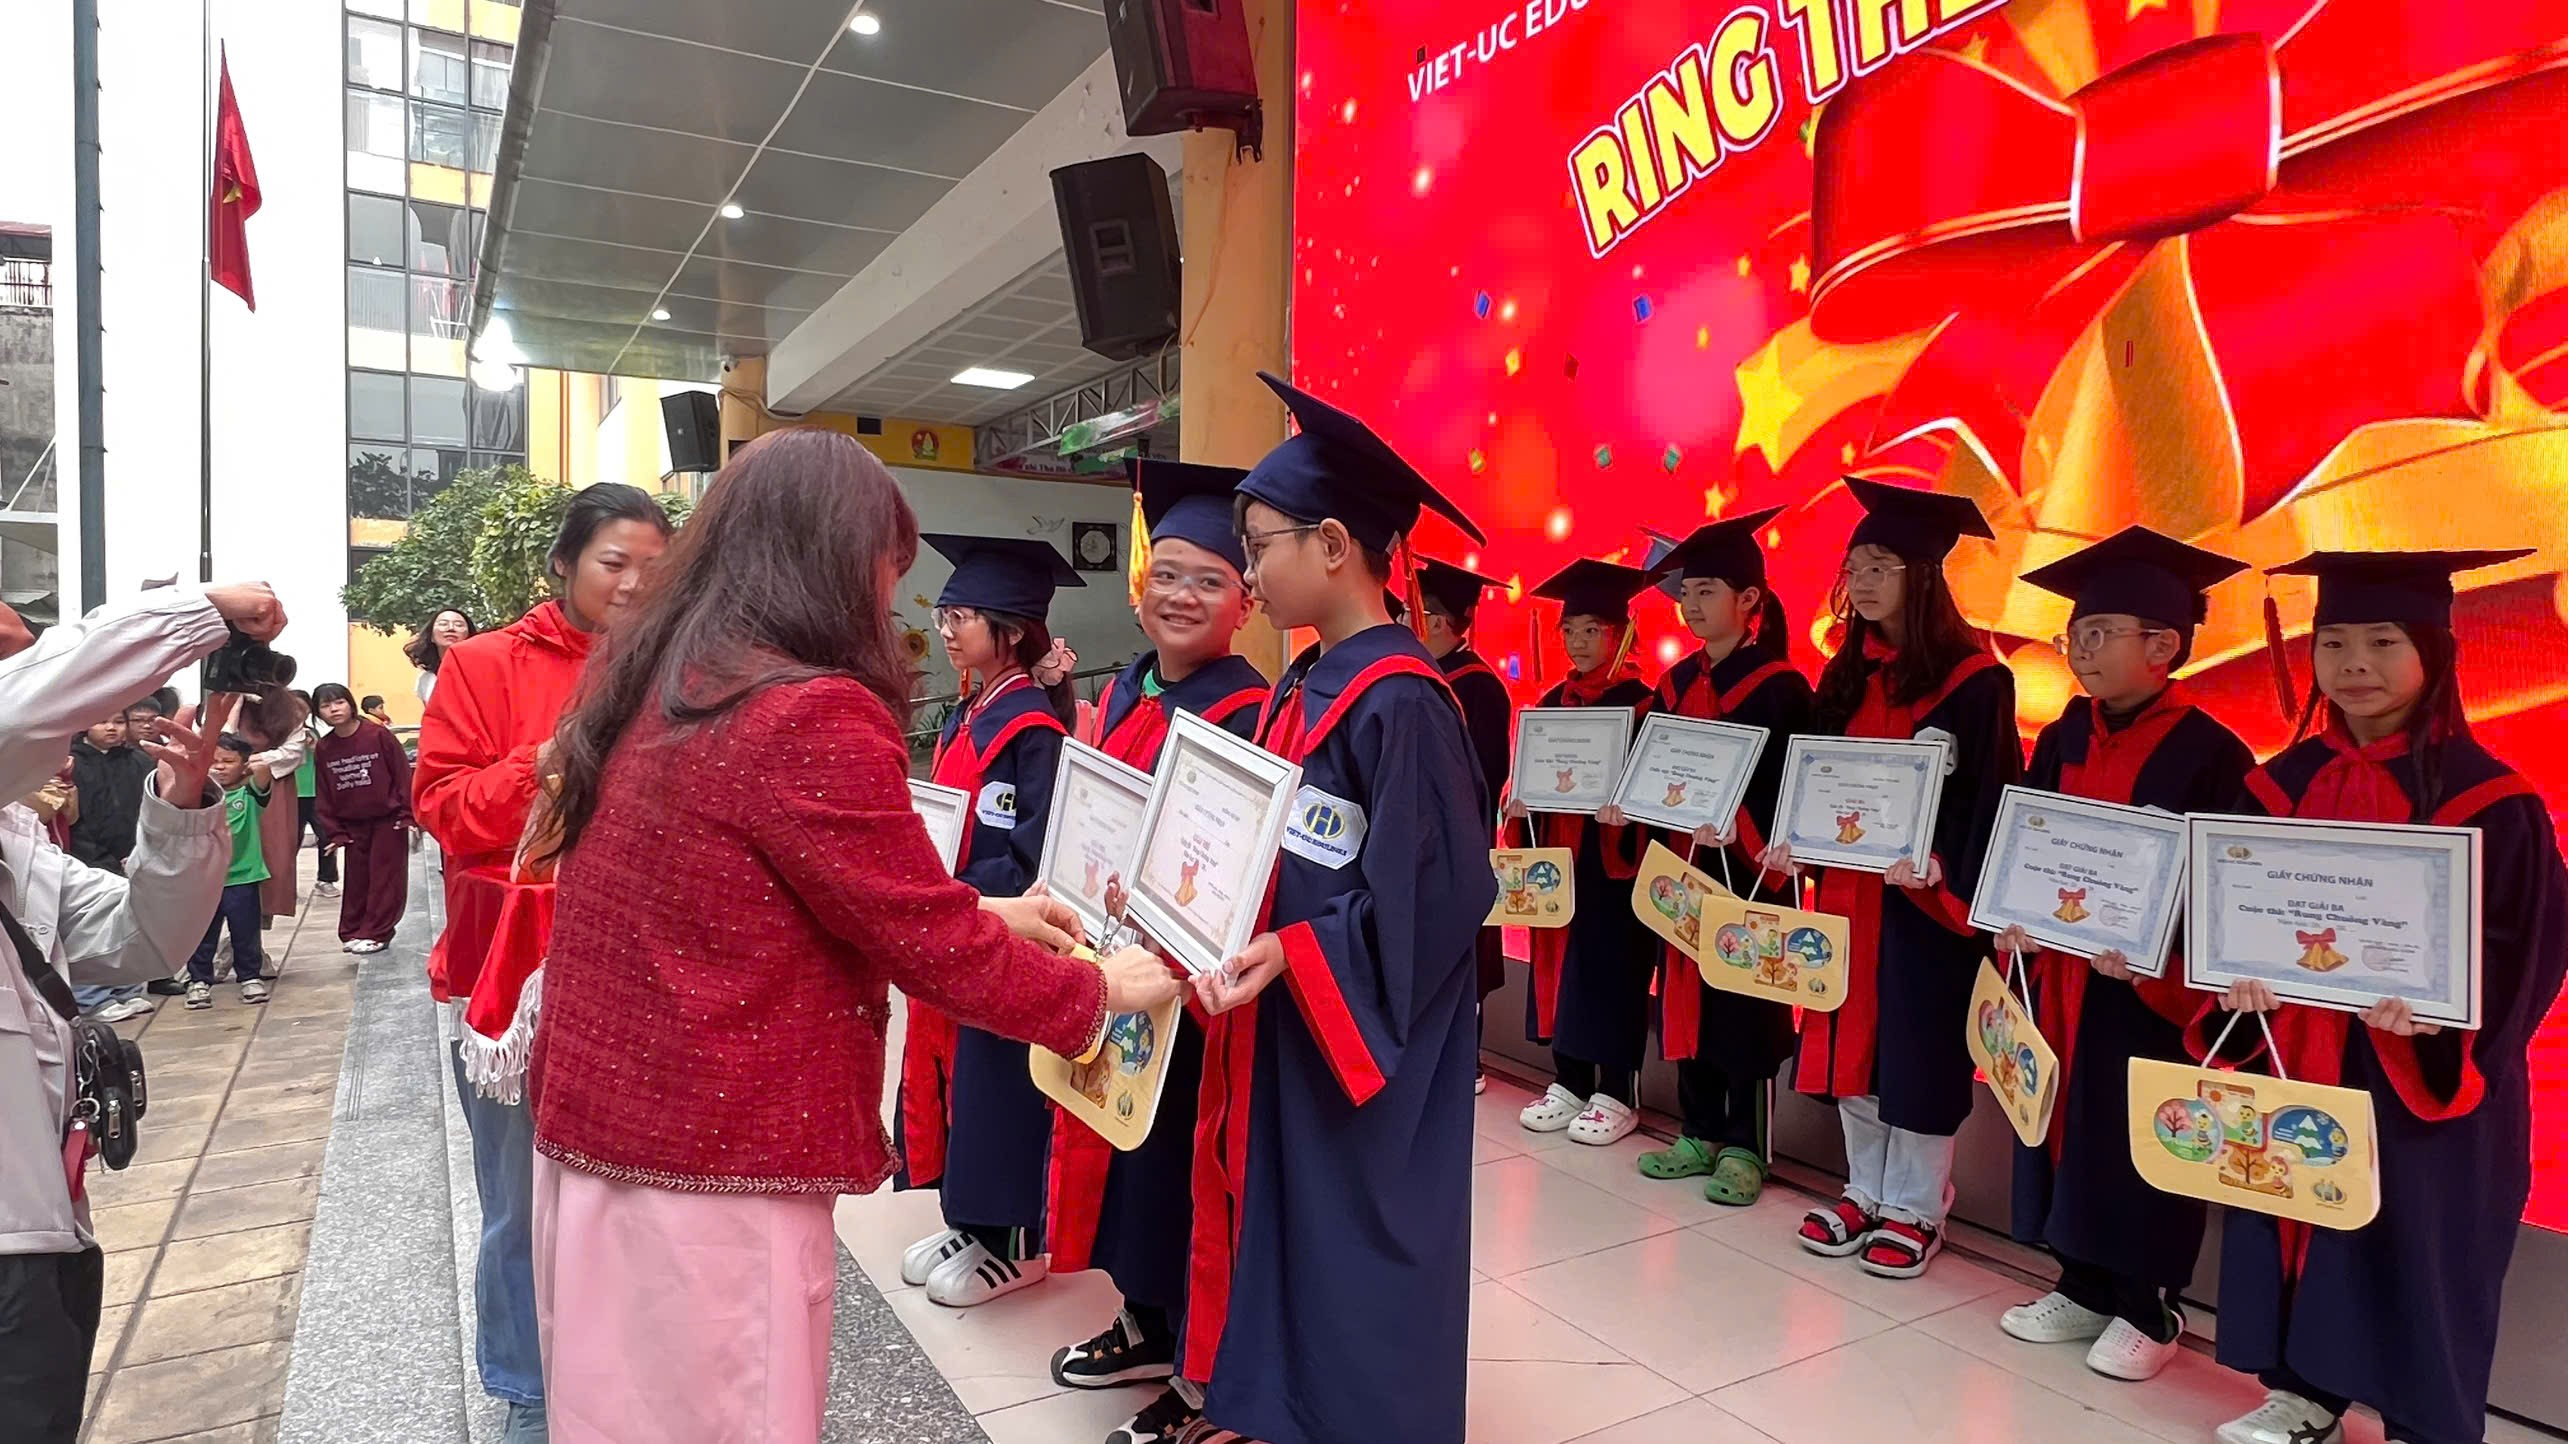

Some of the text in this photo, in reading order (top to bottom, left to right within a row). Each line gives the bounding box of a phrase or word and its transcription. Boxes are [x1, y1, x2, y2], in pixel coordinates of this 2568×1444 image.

[1407, 0, 1590, 103] VIET-UC ED
[1568, 6, 1783, 258] RING
[2294, 871, 2337, 885] CHỨNG
